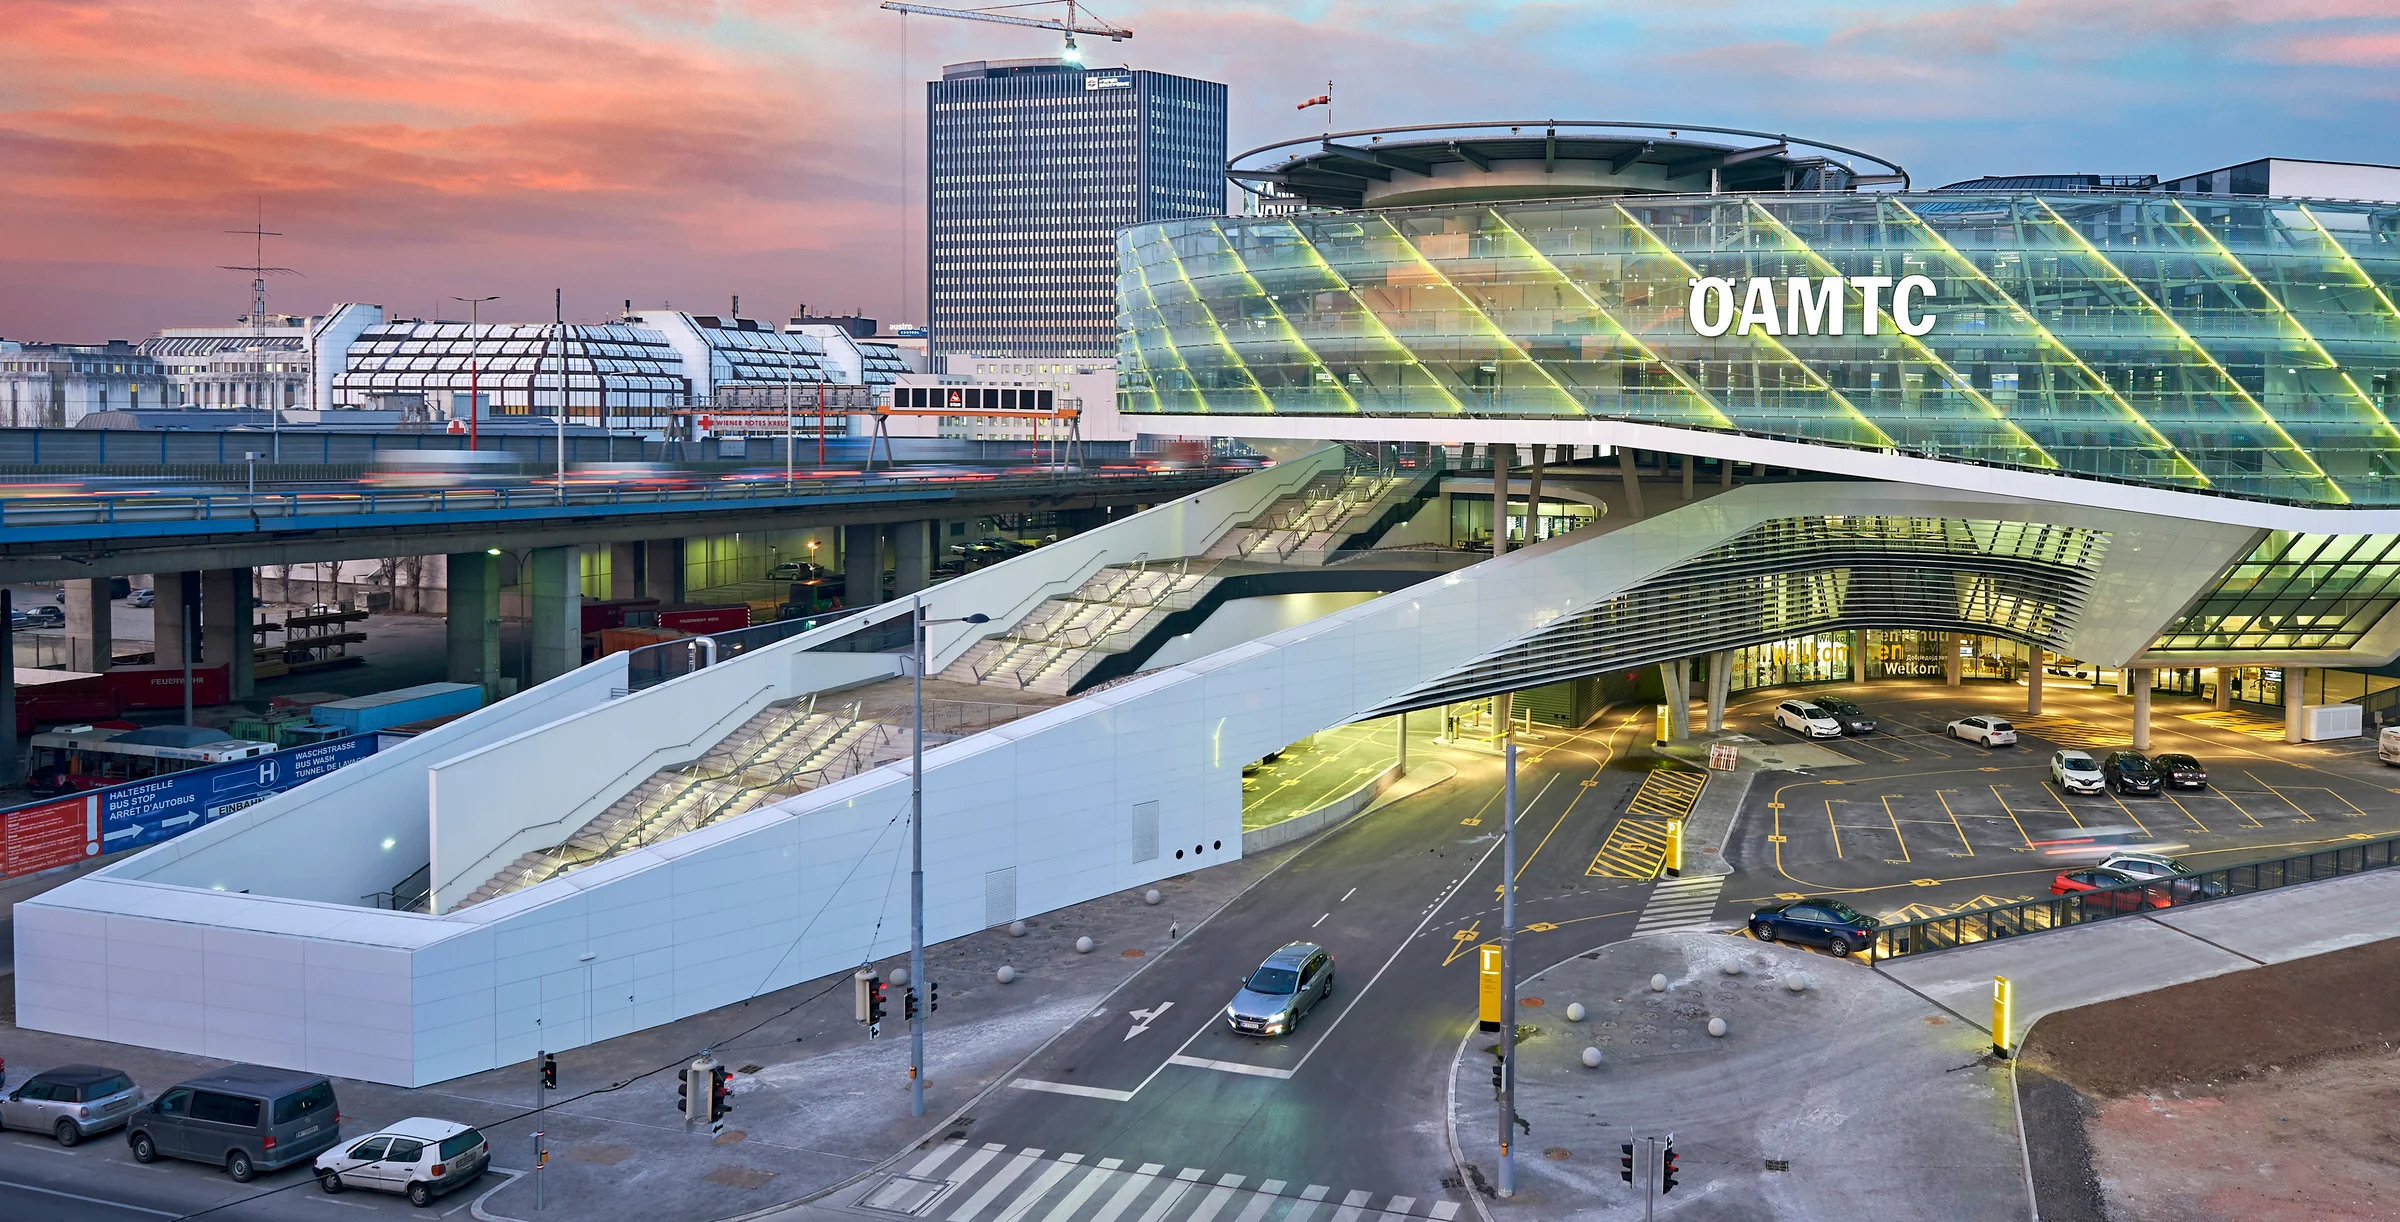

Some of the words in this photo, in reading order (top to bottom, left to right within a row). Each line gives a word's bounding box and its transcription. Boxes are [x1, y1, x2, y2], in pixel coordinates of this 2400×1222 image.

[1688, 274, 1937, 337] ÖAMTC
[1884, 661, 1940, 675] Welkom
[151, 677, 204, 685] FEUERWHR
[295, 741, 356, 760] WASCHSTRASSE
[295, 760, 311, 769] BUS
[313, 754, 335, 765] WASH
[295, 766, 325, 778] TUNNEL
[327, 762, 337, 771] DE
[260, 762, 274, 784] H
[109, 779, 174, 800] HALTESTELLE
[109, 800, 129, 810] BUS
[131, 793, 156, 806] STOP
[143, 794, 195, 813] D'AUTOBUS
